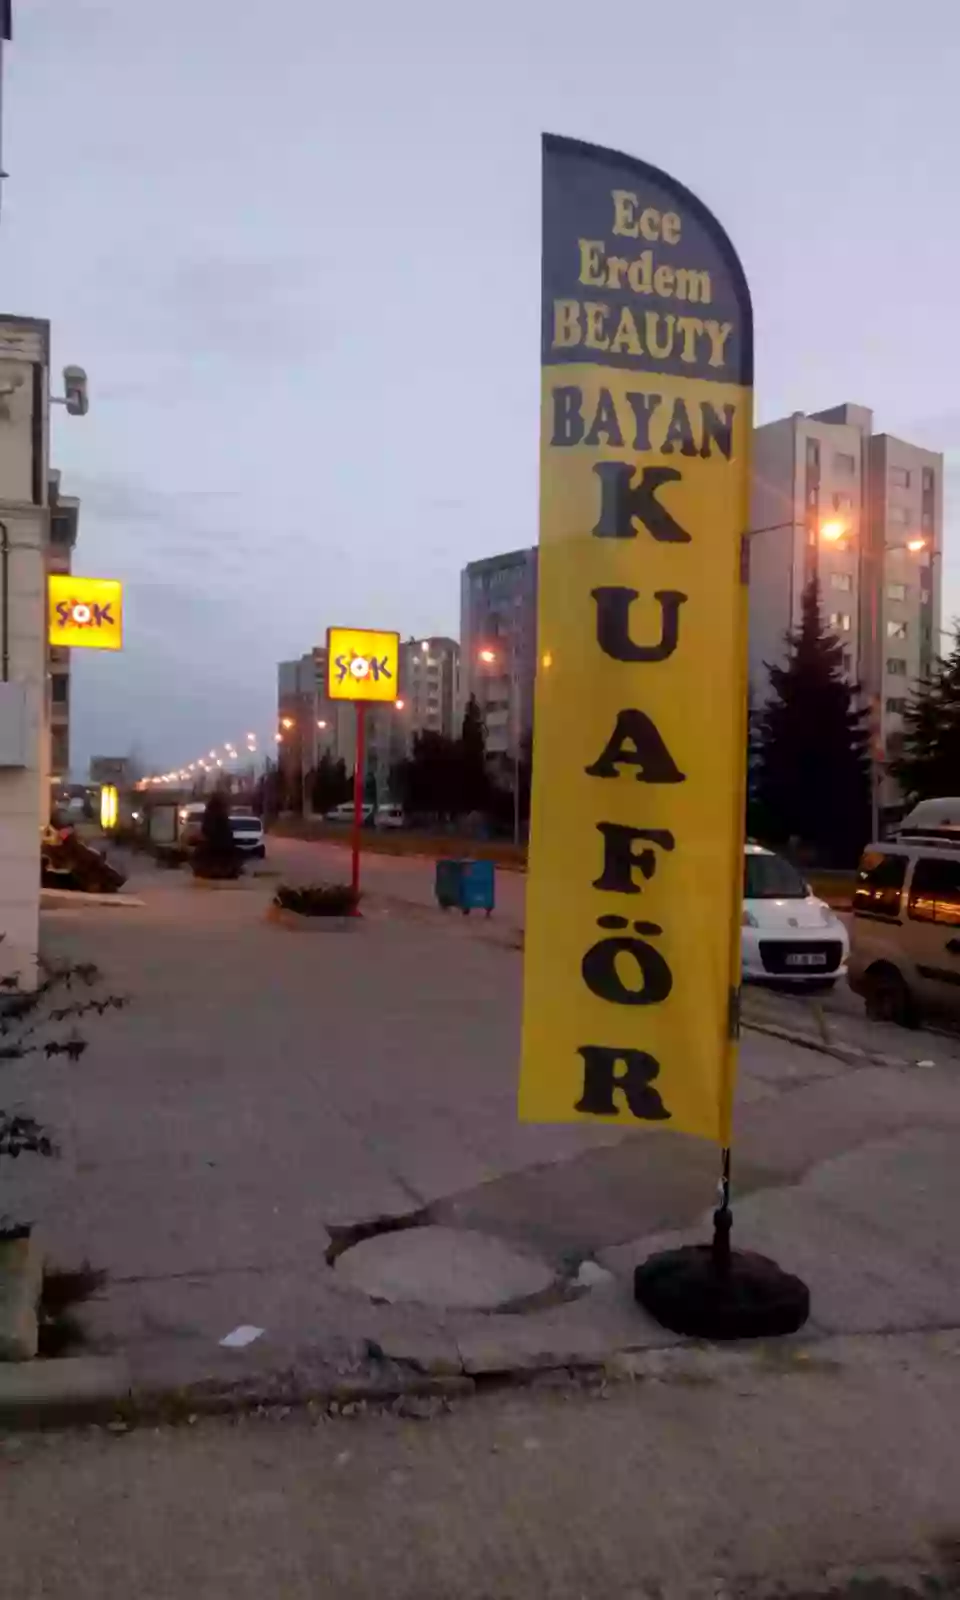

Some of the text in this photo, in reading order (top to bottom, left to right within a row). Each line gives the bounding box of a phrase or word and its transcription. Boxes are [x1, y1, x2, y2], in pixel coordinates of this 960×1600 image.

[611, 189, 682, 245] Ece
[577, 238, 712, 305] Erdem
[552, 299, 732, 369] BEAUTY
[549, 386, 736, 461] BAYAN
[334, 653, 392, 686] ŞOK
[573, 461, 692, 1120] KUAFÖR
